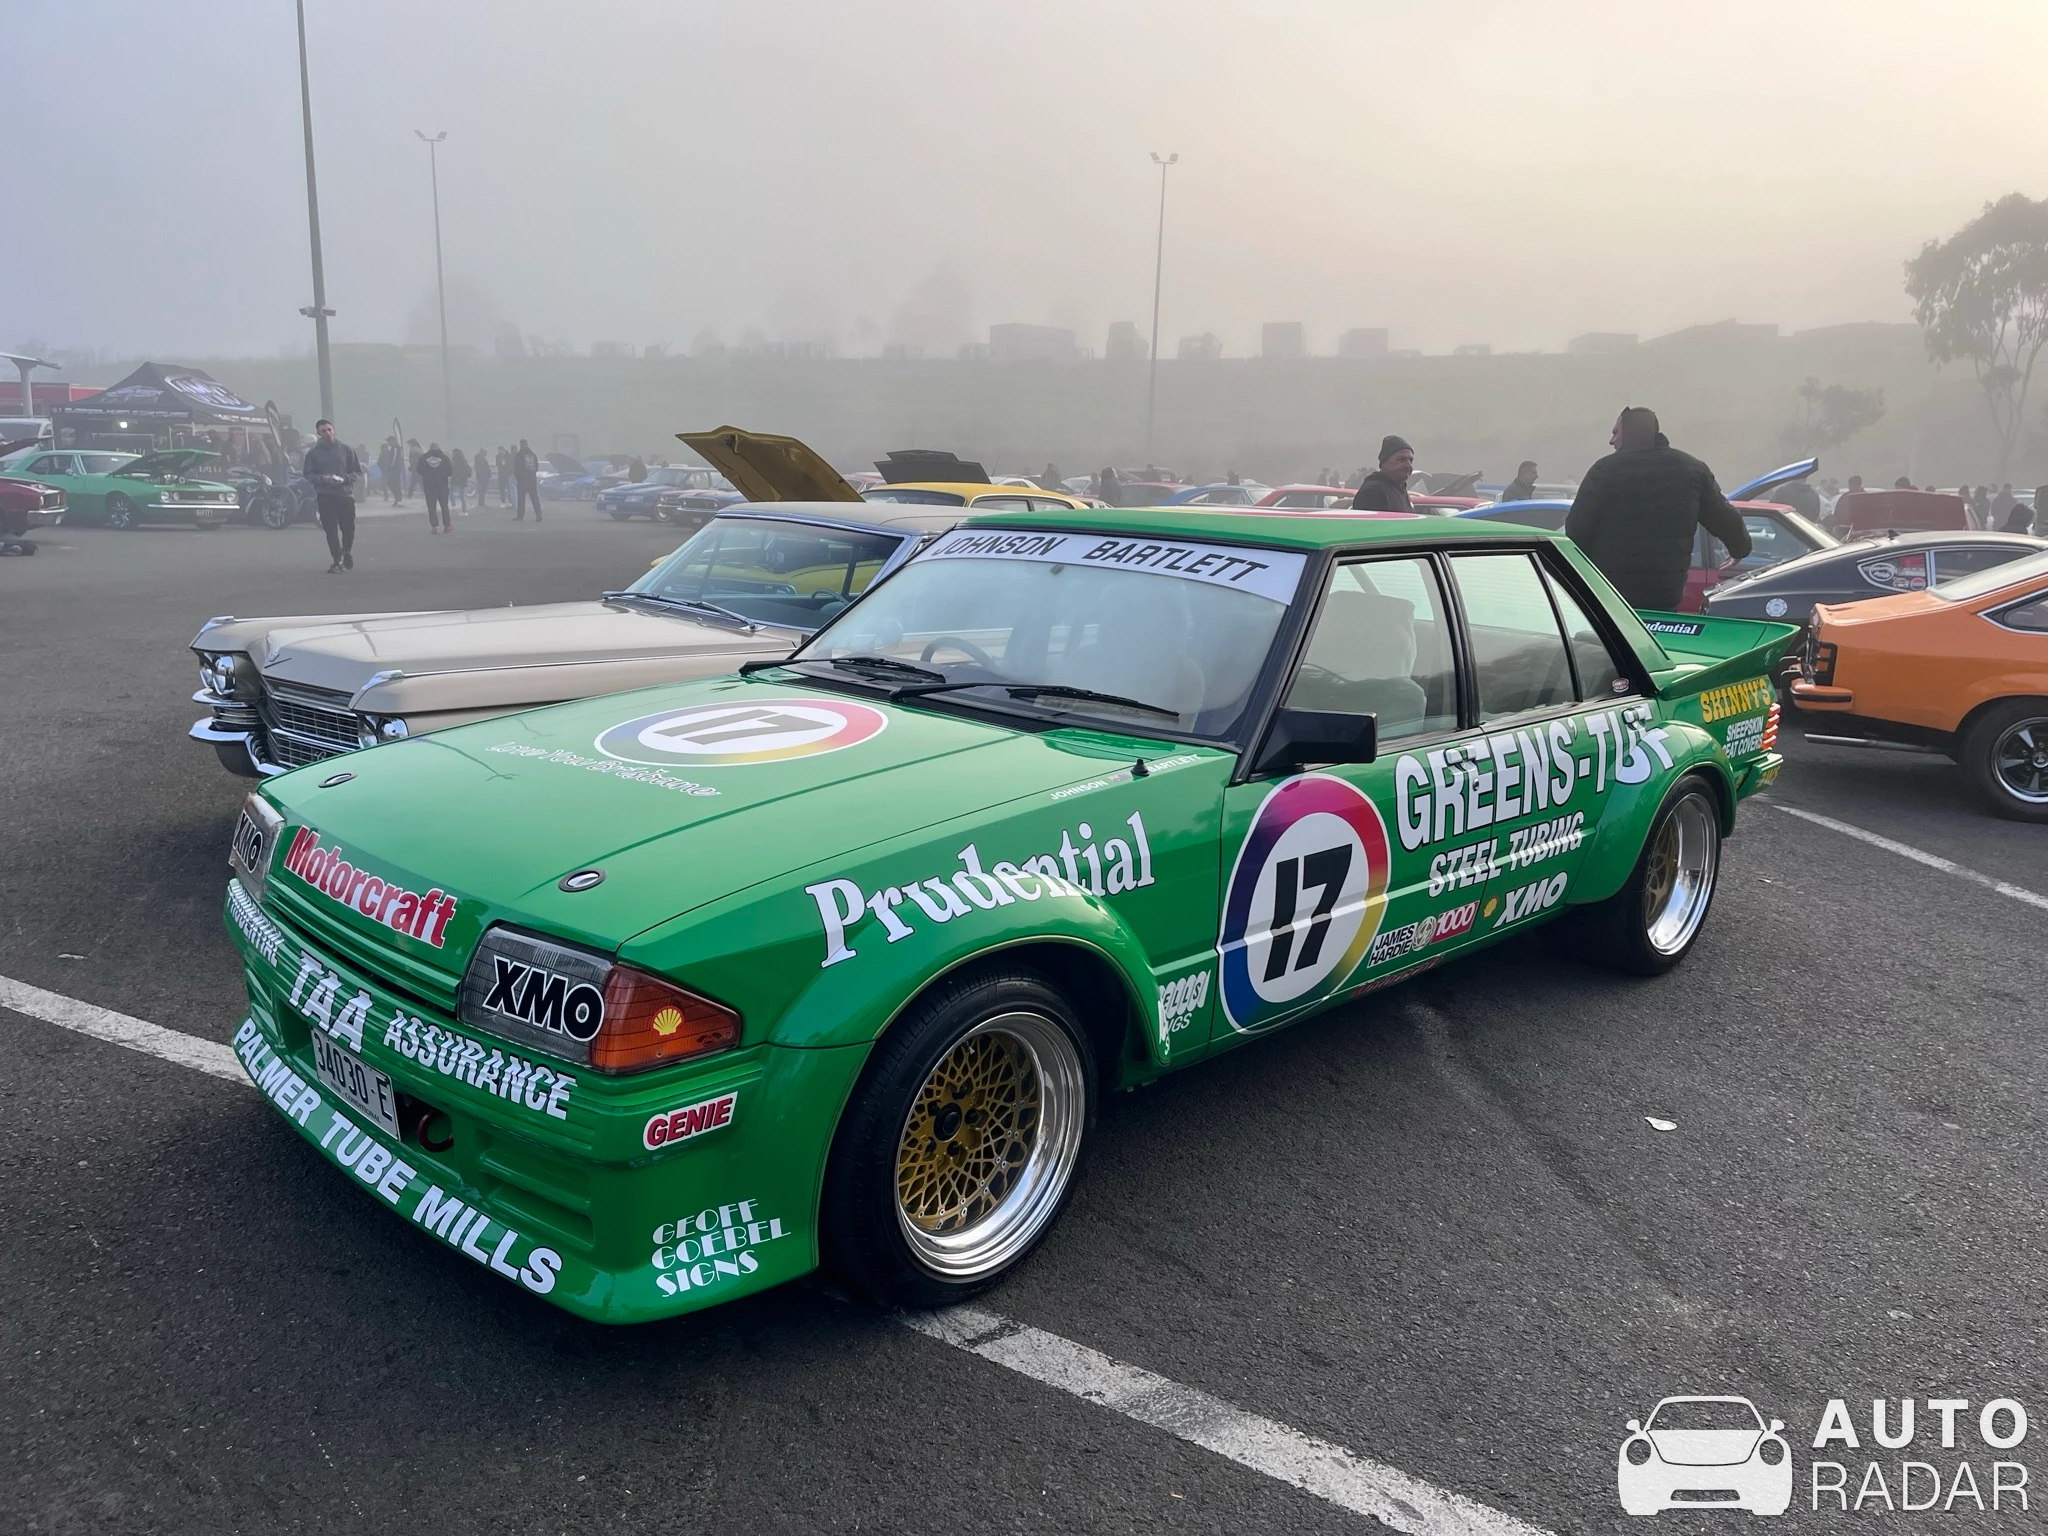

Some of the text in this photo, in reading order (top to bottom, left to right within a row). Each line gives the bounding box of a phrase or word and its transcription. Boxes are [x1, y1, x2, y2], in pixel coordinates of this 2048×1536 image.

[935, 536, 1270, 582] JOHNSON BARTLETT
[1644, 622, 1698, 635] udential
[1700, 676, 1771, 723] SKINNY'S
[652, 708, 834, 746] 17
[1726, 715, 1763, 742] SHEEPSKIN
[1738, 733, 1764, 756] COVERS
[1050, 753, 1201, 801] JOHNSON BARTLETT
[232, 811, 263, 873] XMO
[1428, 810, 1585, 898] STEEL TUBING
[284, 824, 457, 949] Motorcraft
[805, 810, 1155, 969] Prudential
[1493, 871, 1568, 929] XMO
[1263, 843, 1353, 983] 17
[1375, 924, 1415, 950] JAMES
[1436, 902, 1477, 936] 1000
[1368, 939, 1413, 966] HARDIE
[482, 955, 604, 1041] XMO
[289, 950, 374, 1053] TAA
[384, 1008, 578, 1120] ASSURANCE
[345, 1093, 382, 1124] CONDITIONAL
[645, 1096, 735, 1147] GENIE
[233, 1018, 563, 1294] PALMER TUBE MILLS
[651, 1217, 791, 1270] GOEBEL
[652, 1199, 759, 1244] GEOFF
[655, 1249, 759, 1297] SIGNS
